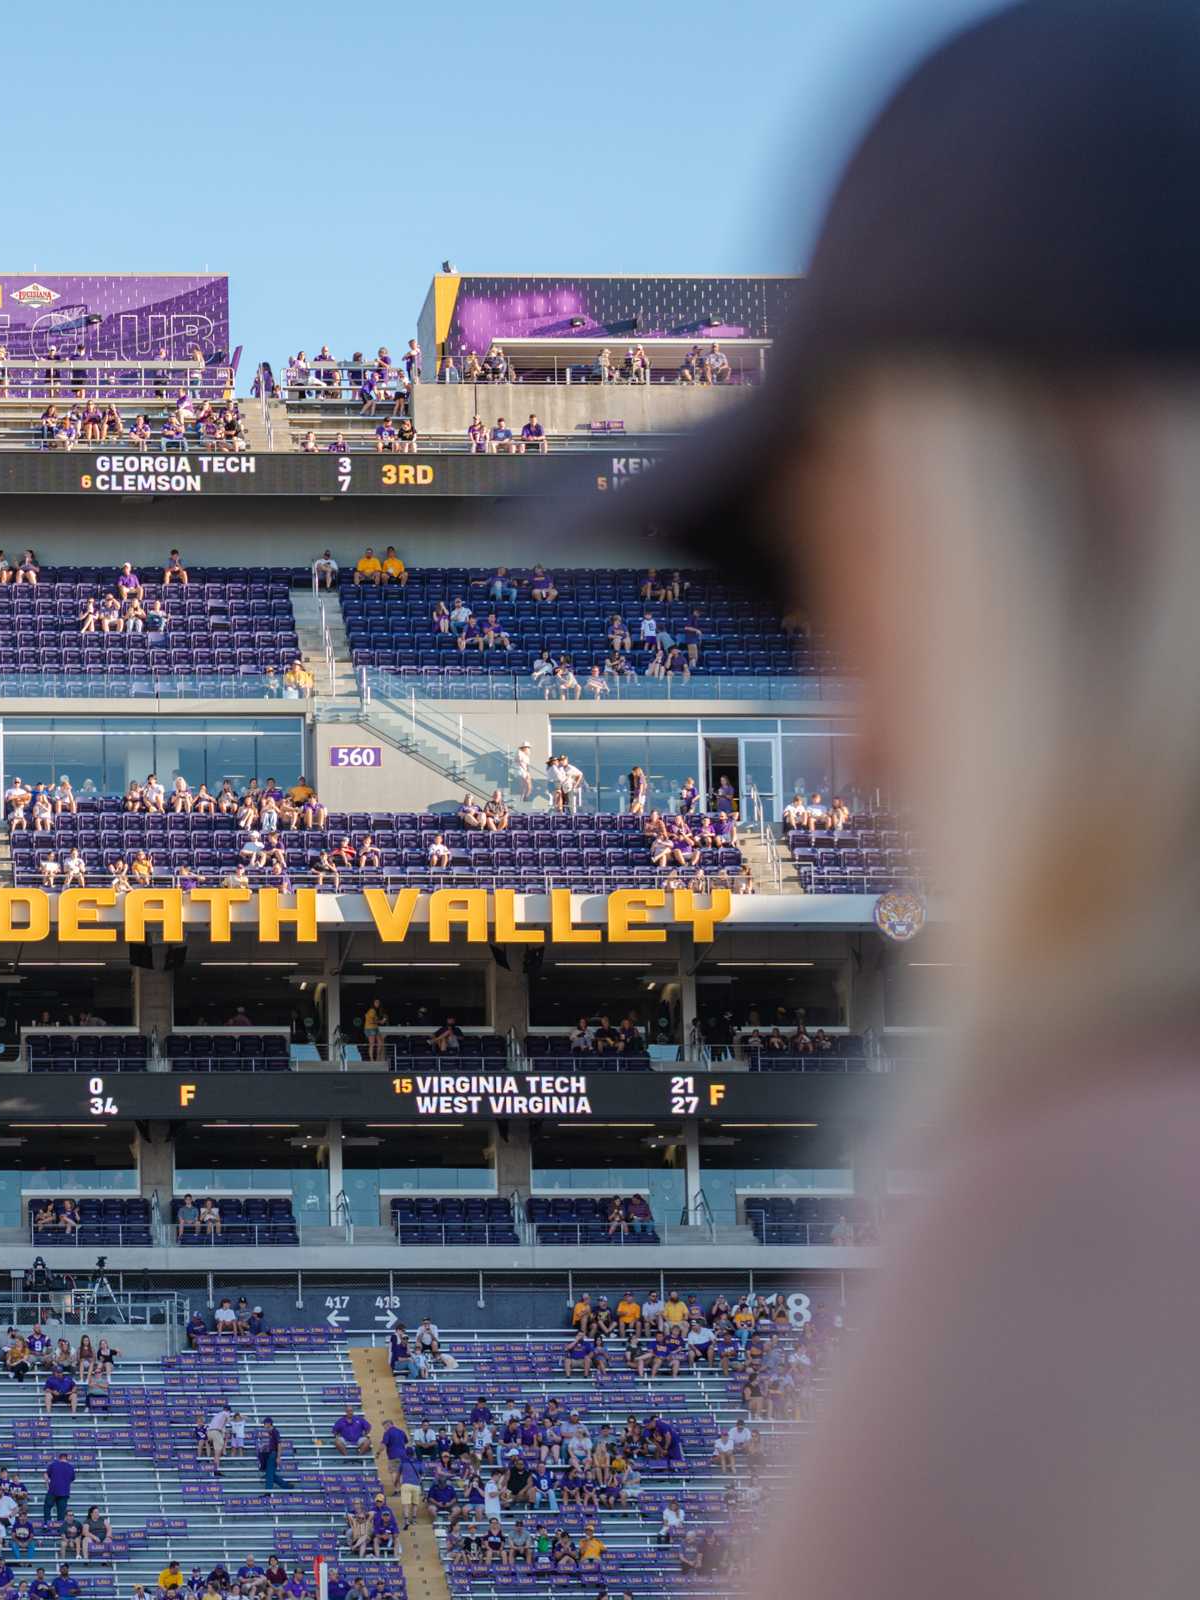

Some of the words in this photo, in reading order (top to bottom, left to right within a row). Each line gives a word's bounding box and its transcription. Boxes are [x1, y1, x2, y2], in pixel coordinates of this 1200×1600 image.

[31, 313, 218, 361] CLUB
[96, 456, 191, 472] GEORGIA
[198, 457, 256, 473] TECH
[338, 457, 351, 473] 3
[81, 475, 92, 488] 6
[96, 475, 201, 491] CLEMSON
[381, 464, 434, 485] 3RD
[338, 476, 351, 491] 7
[338, 748, 374, 766] 560
[365, 889, 731, 943] VALLEY
[90, 1078, 103, 1095] 0
[393, 1079, 412, 1093] 15
[416, 1077, 518, 1093] VIRGINIA
[526, 1077, 585, 1093] TECH
[671, 1077, 694, 1093] 21
[181, 1085, 195, 1106] F
[710, 1085, 725, 1105] F
[90, 1098, 118, 1115] 34
[416, 1097, 481, 1113] WEST
[489, 1097, 591, 1113] VIRGINIA
[671, 1097, 698, 1113] 27
[325, 1296, 349, 1309] 417
